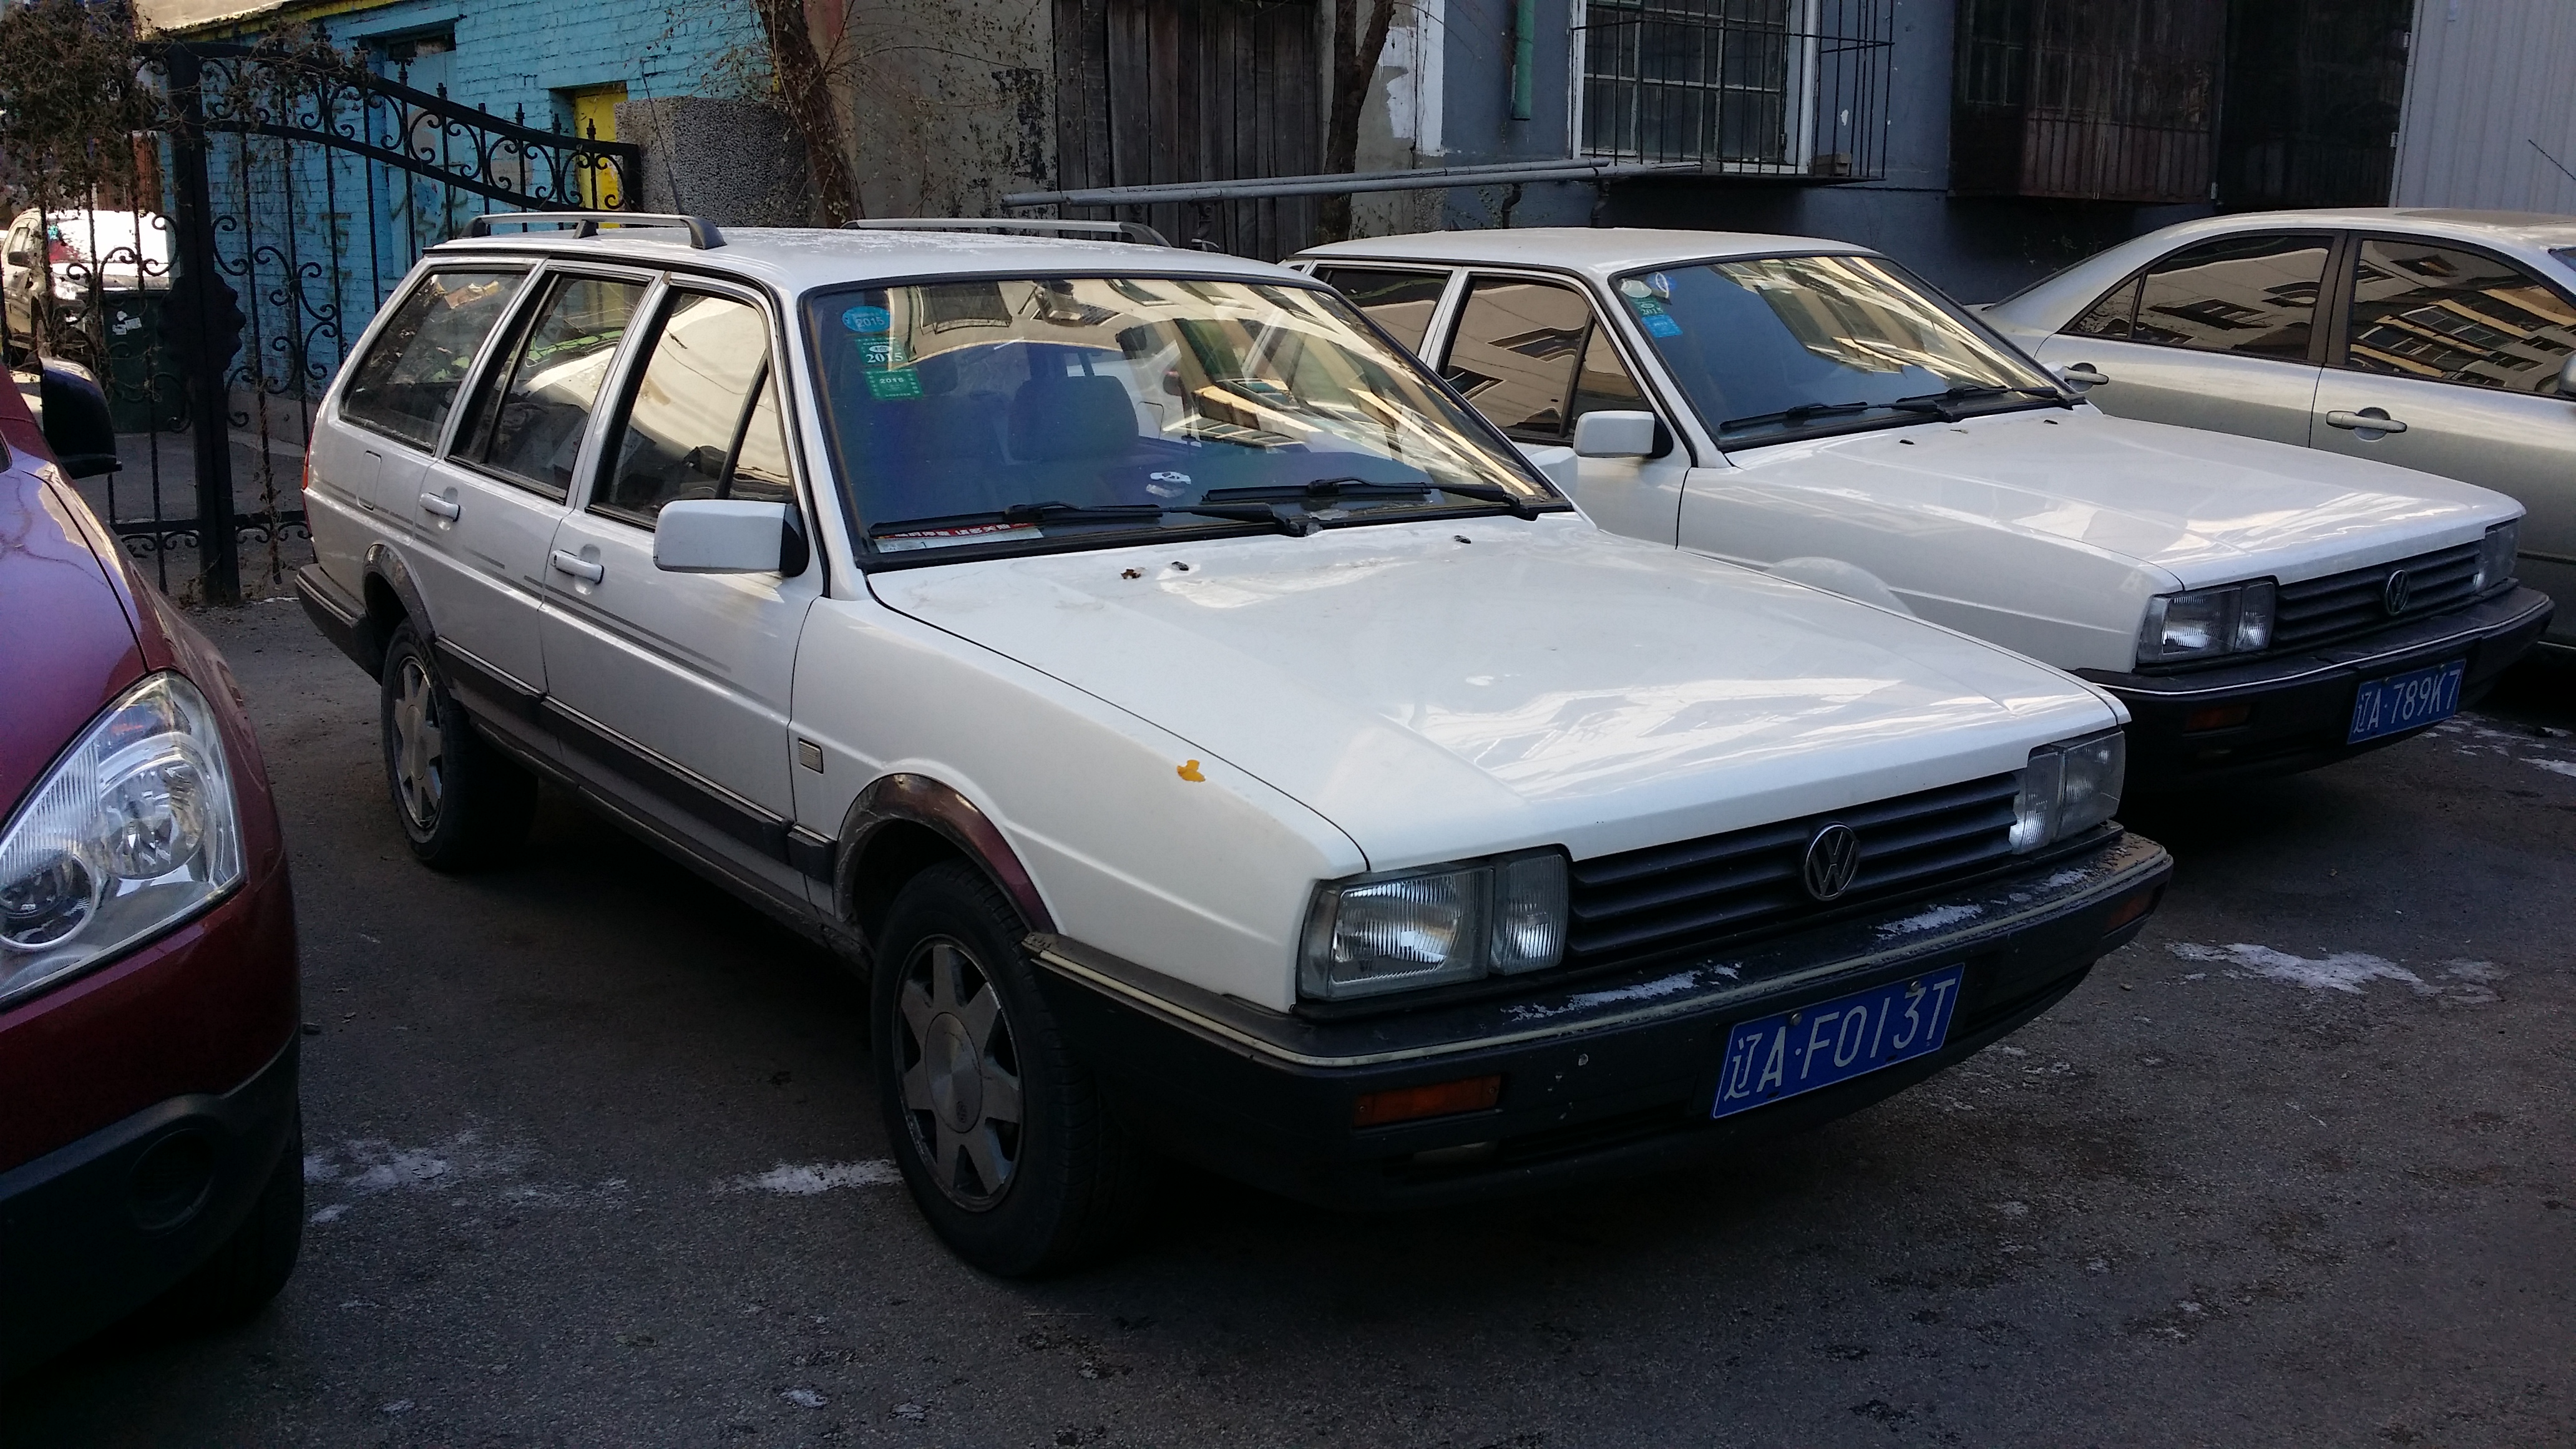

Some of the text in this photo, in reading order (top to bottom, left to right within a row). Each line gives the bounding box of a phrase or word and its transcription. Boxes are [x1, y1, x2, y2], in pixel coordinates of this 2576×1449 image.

[856, 317, 884, 328] 2015
[866, 353, 903, 363] 2015
[2353, 668, 2461, 733] 辽A·789K7
[1805, 822, 1860, 900] VW
